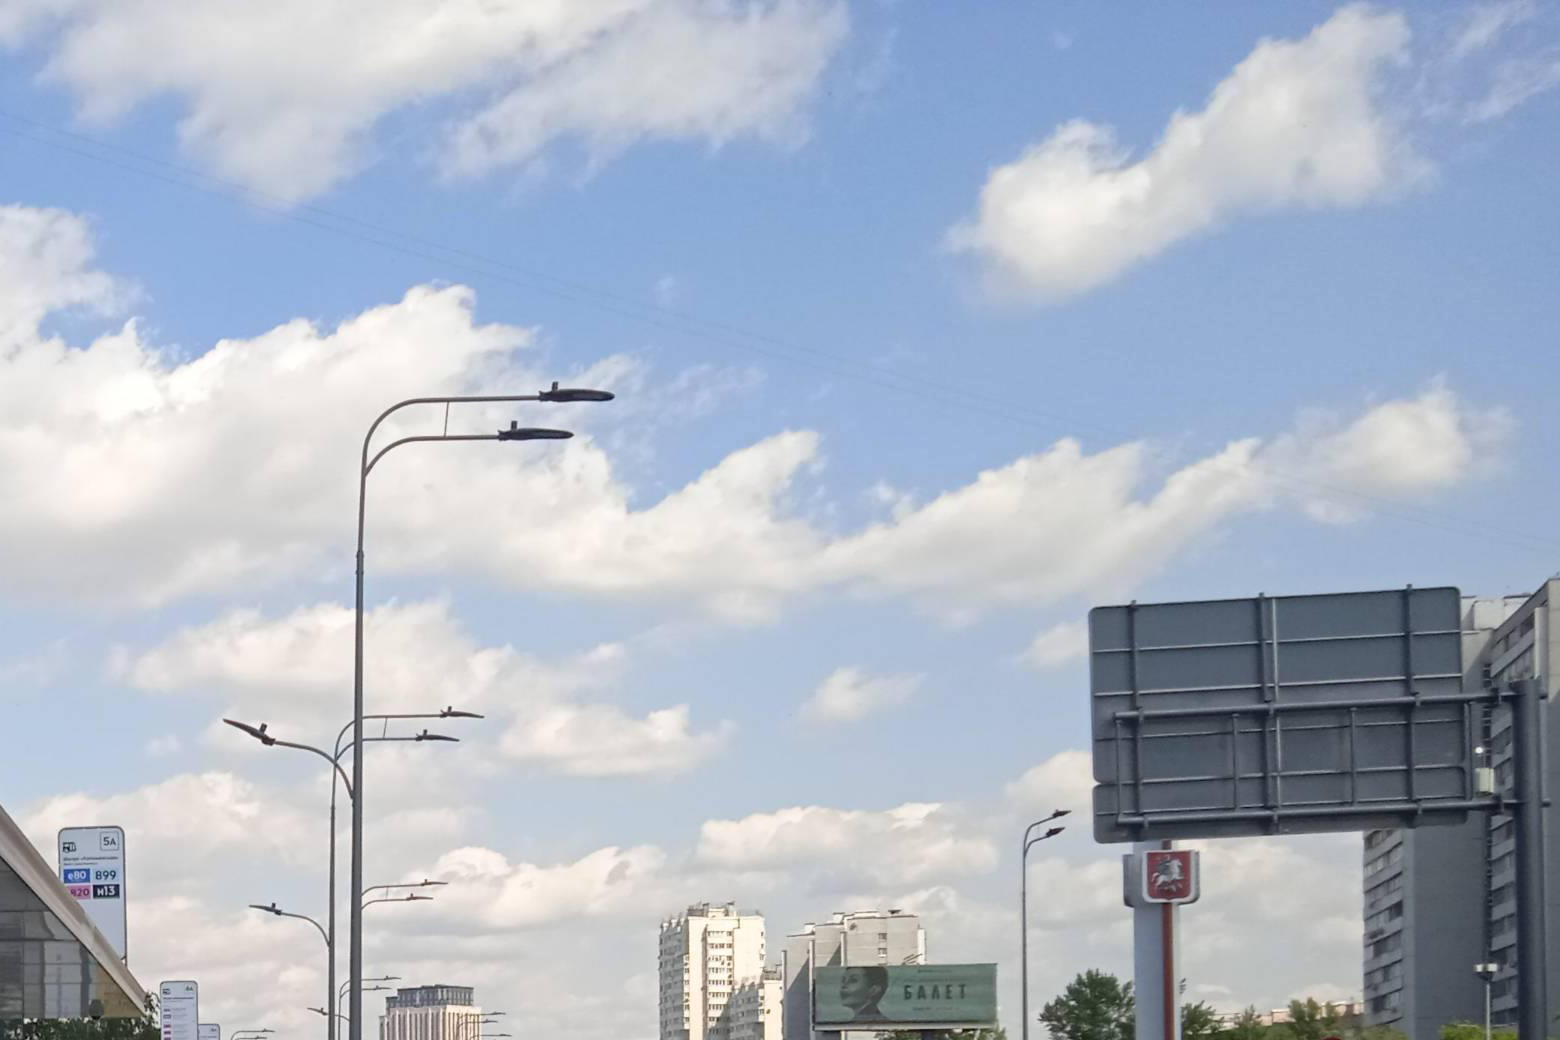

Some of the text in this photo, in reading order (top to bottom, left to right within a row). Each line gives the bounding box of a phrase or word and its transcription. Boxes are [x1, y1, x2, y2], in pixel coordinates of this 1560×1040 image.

[103, 837, 117, 846] 5А
[95, 870, 117, 880] 899
[97, 886, 116, 896] н13
[904, 984, 966, 1000] БАЛЕТ
